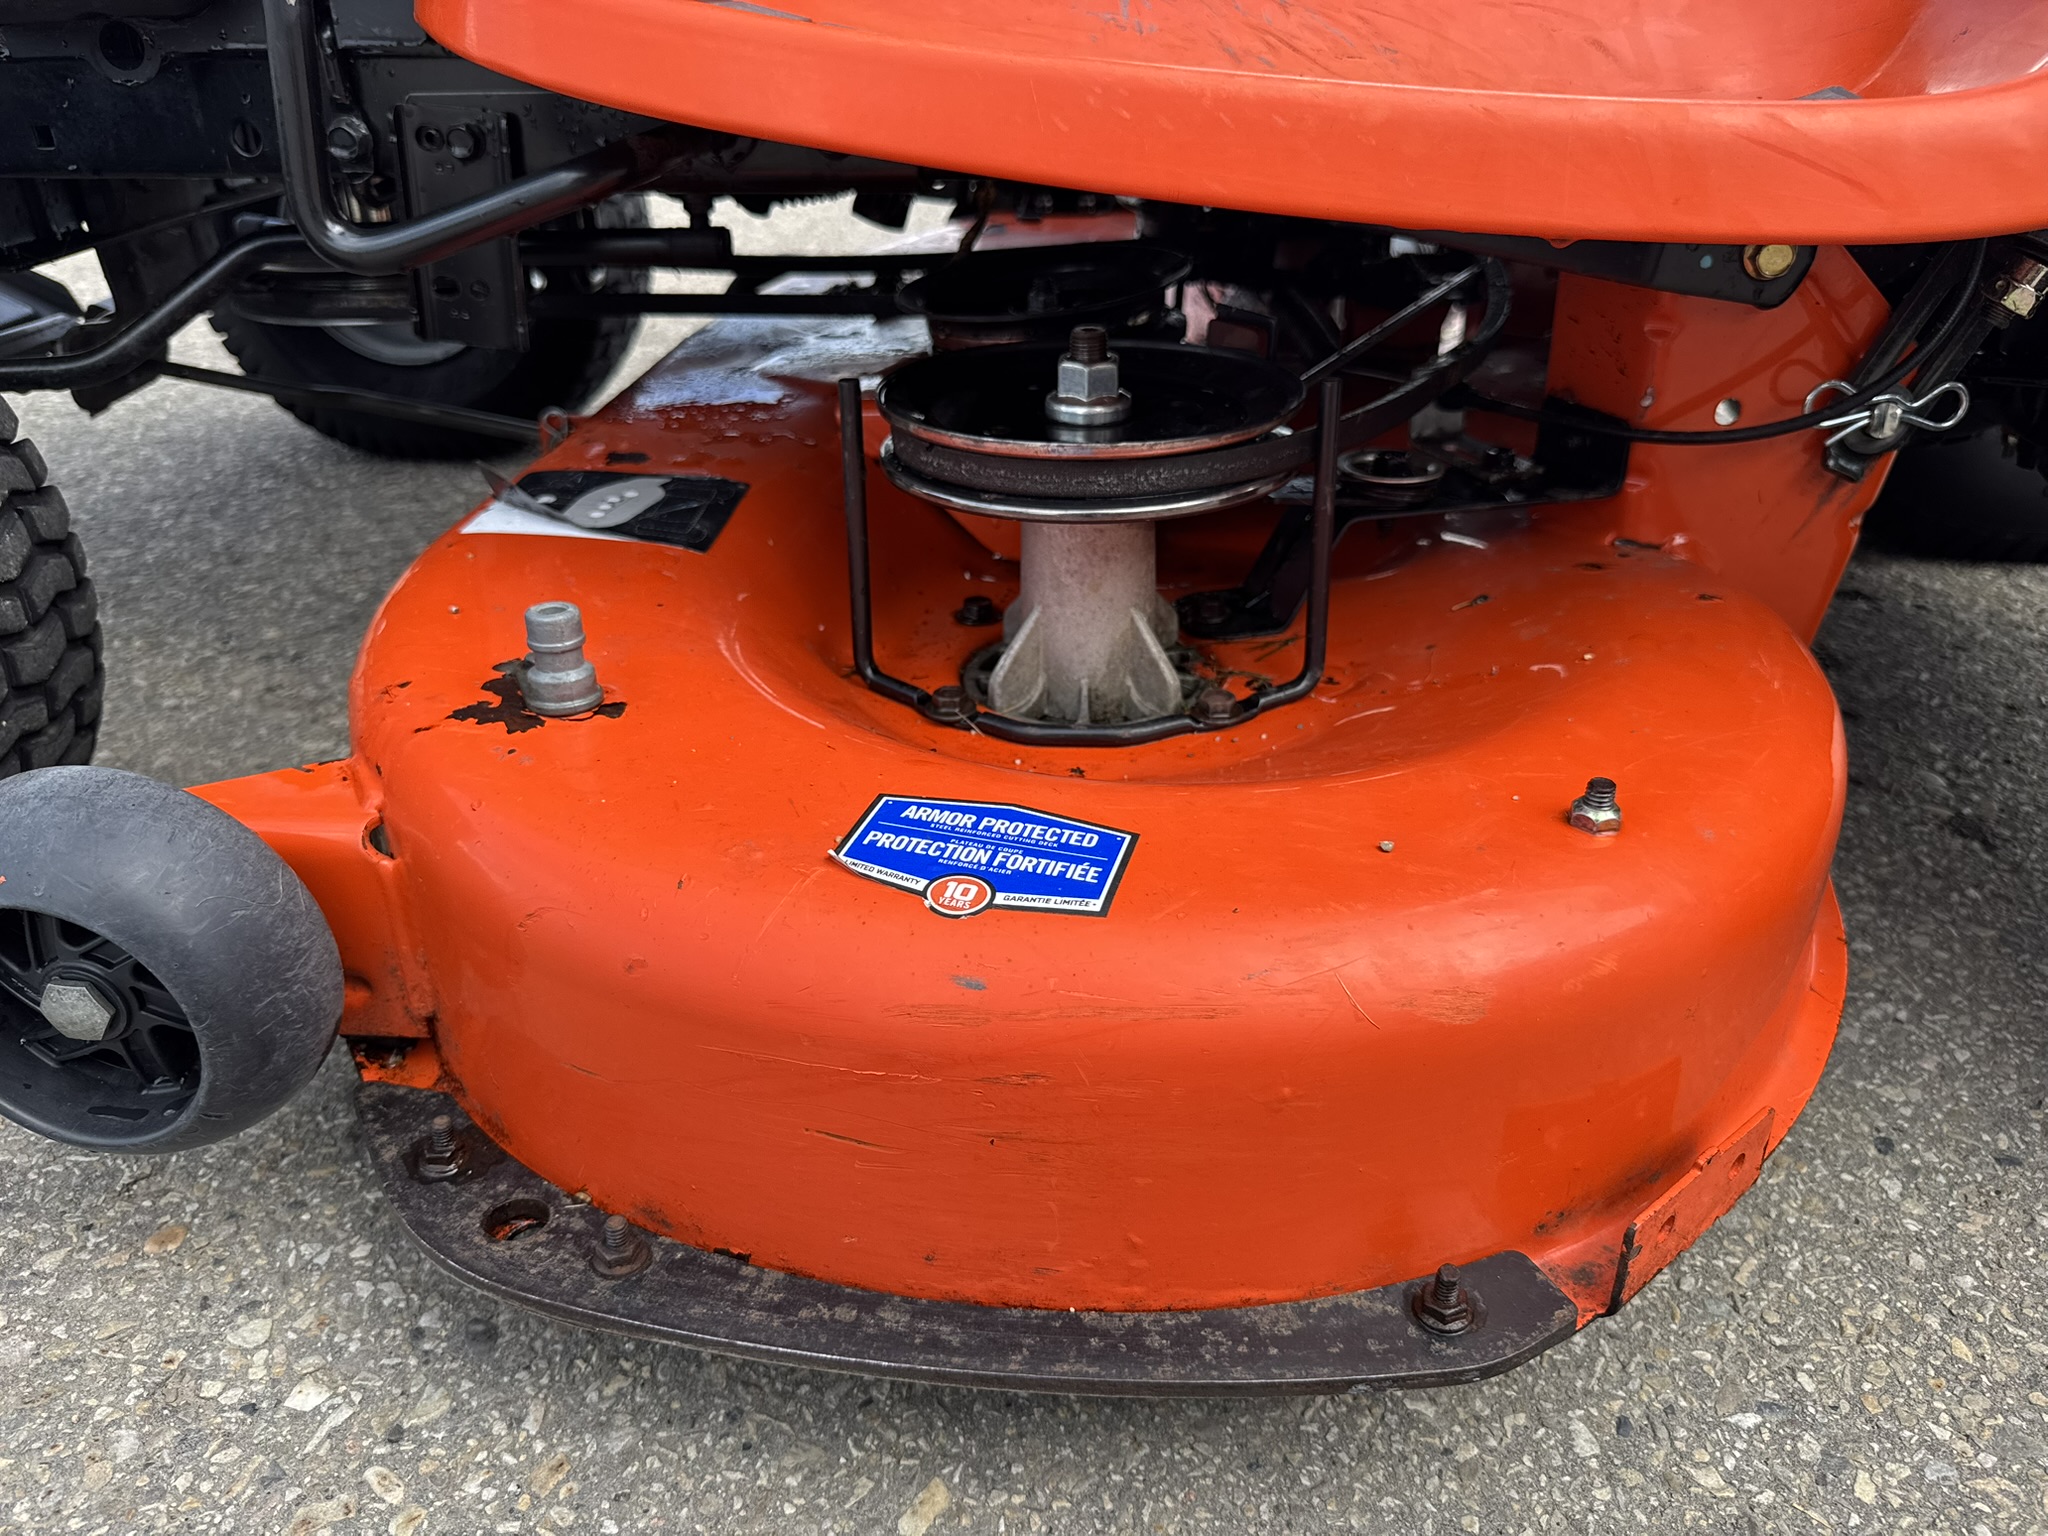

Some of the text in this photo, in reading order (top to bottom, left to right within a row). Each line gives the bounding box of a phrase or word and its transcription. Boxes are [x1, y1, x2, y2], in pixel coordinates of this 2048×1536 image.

[900, 805, 1099, 848] ARMOR PROTECTED
[930, 823, 1058, 848] STEEL REINFORCED CUTTING DECK
[950, 838, 983, 848] PLATEAU
[998, 846, 1024, 854] COUPE
[862, 830, 1103, 884] PROTECTION FORTIFIÉE
[937, 858, 1012, 875] RENFORCÉ D'ACIER
[844, 859, 921, 885] LIMITED WARRANTY
[943, 881, 979, 902] 10
[1002, 894, 1091, 907] GARANTIE LIMITÉE
[938, 896, 972, 909] YEARS
